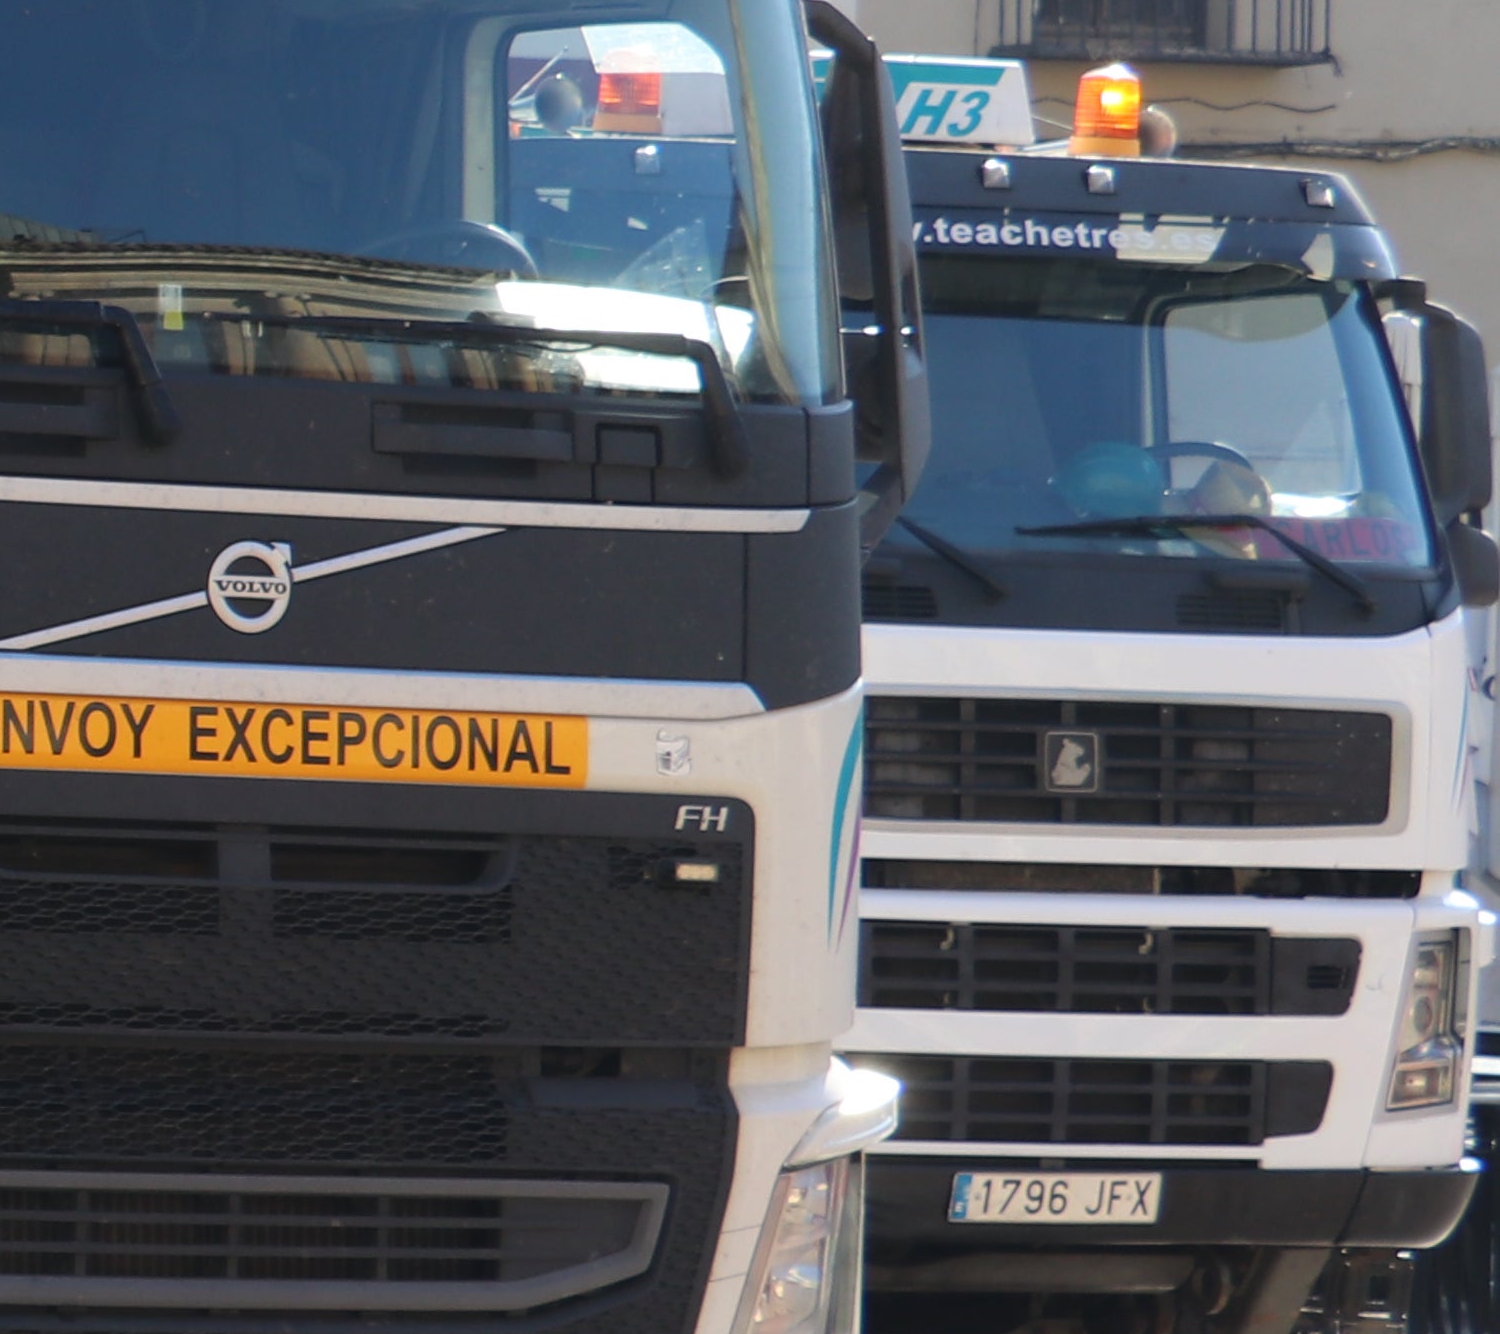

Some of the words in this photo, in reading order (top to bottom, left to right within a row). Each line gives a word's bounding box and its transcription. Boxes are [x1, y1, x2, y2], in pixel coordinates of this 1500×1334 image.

[214, 579, 288, 595] VOLVO
[186, 703, 572, 776] EXCEPCIONAL
[674, 804, 729, 832] FH
[980, 1179, 1069, 1216] 1796
[1084, 1179, 1154, 1217] JFX
